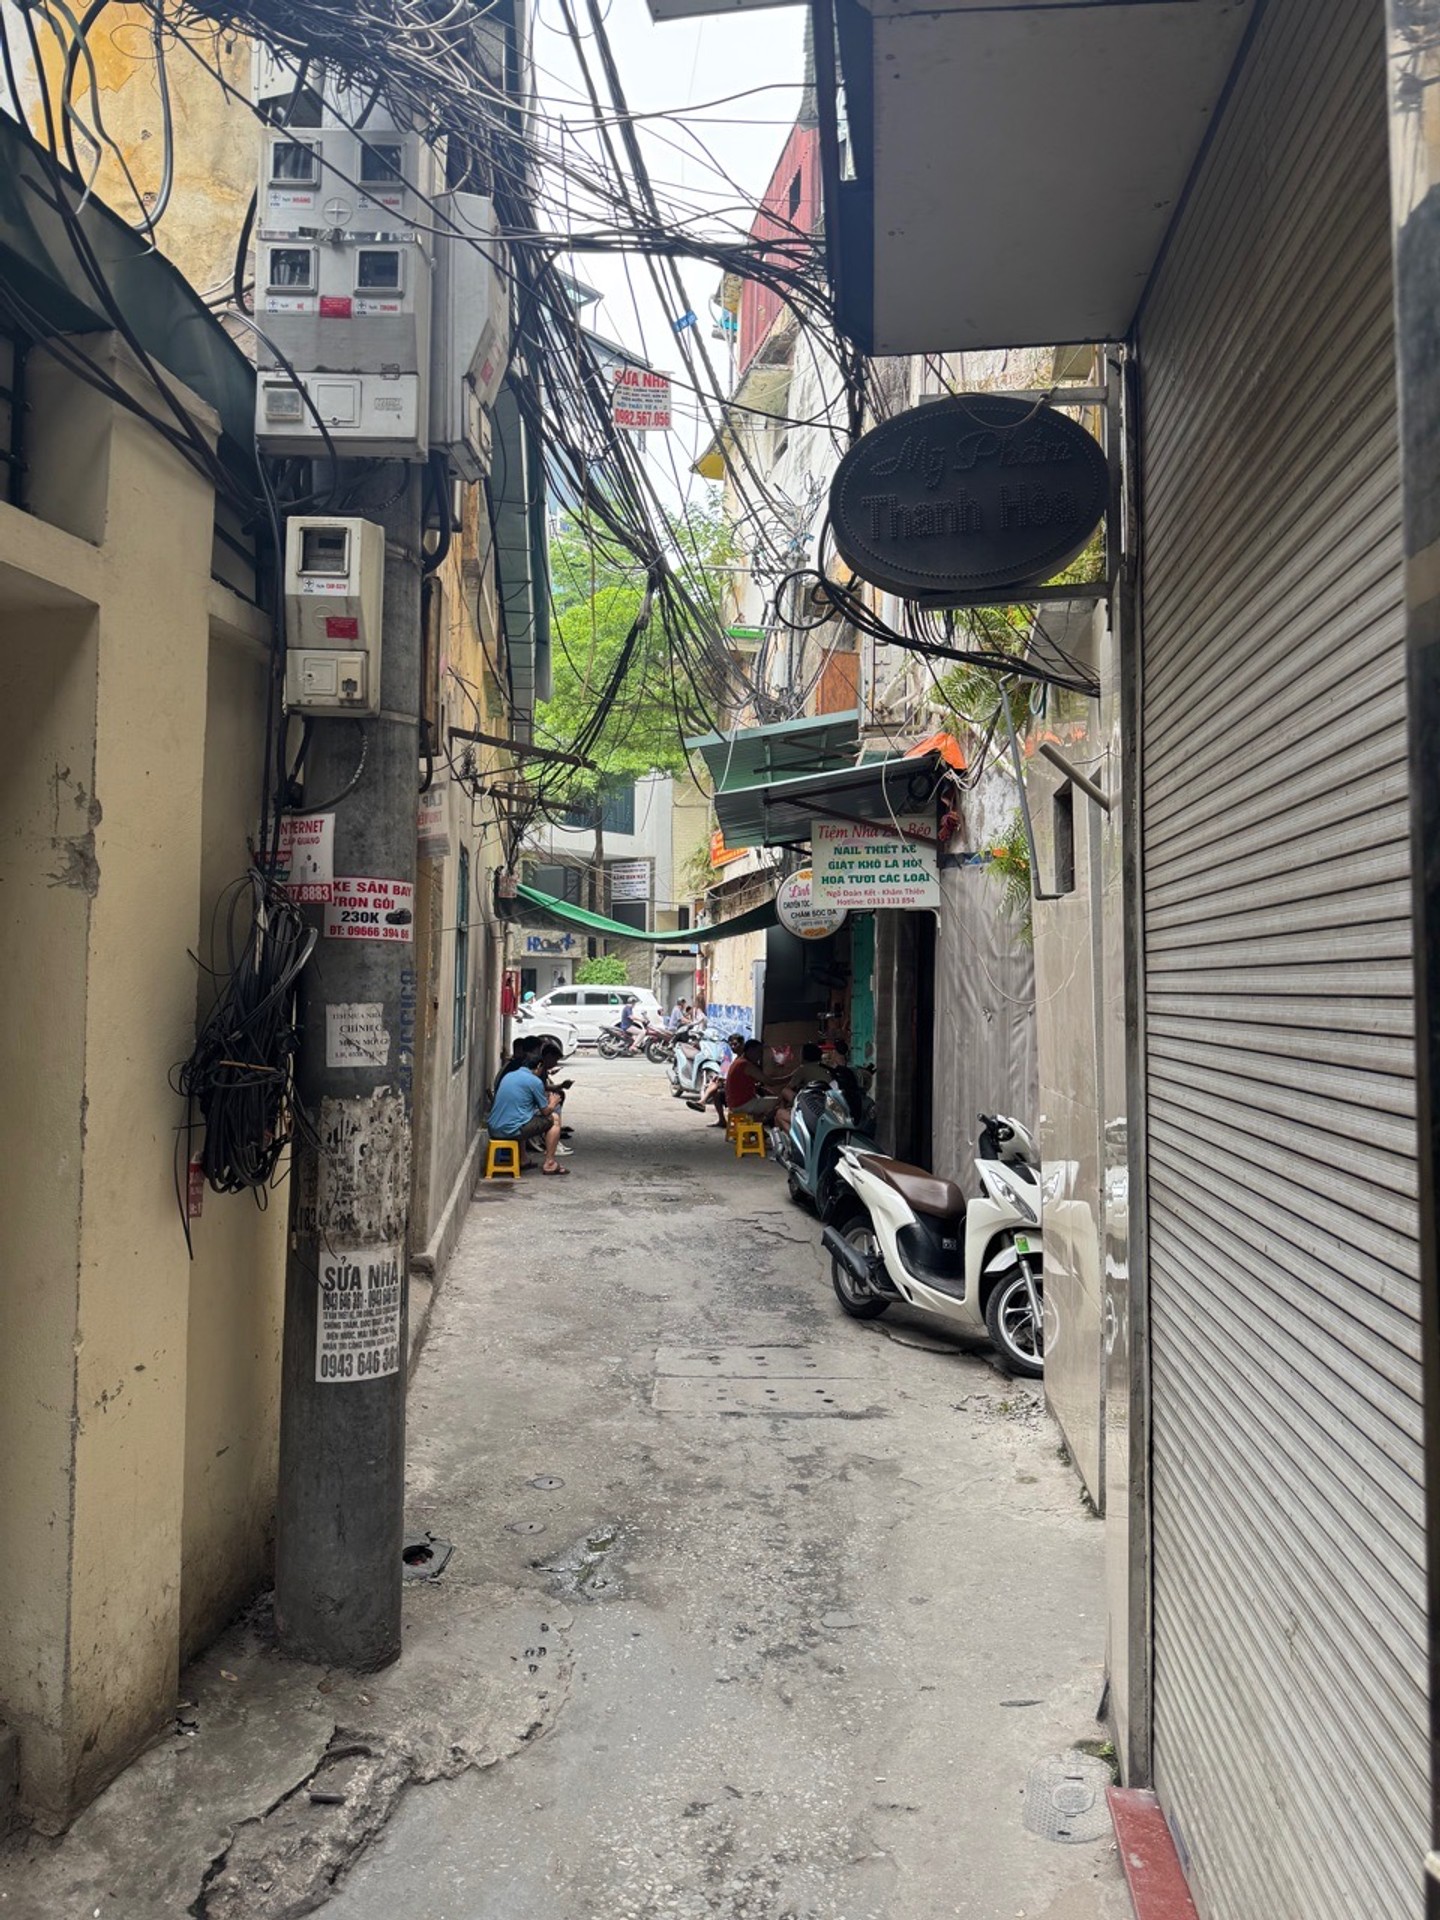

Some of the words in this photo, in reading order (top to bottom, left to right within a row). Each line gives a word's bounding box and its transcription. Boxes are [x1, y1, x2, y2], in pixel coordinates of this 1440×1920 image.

[861, 487, 983, 540] Thanh
[280, 819, 325, 835] NTERNET
[834, 846, 861, 855] NAIL
[821, 876, 845, 884] HOA
[333, 882, 350, 892] XE
[356, 881, 388, 894] SÂN
[393, 885, 412, 897] BAY
[341, 911, 379, 923] 230K
[330, 926, 344, 935] ĐT:
[324, 1256, 362, 1291] SỬA
[368, 1256, 398, 1289] NHÀ
[321, 1354, 353, 1378] 0943
[358, 1350, 380, 1376] 646
